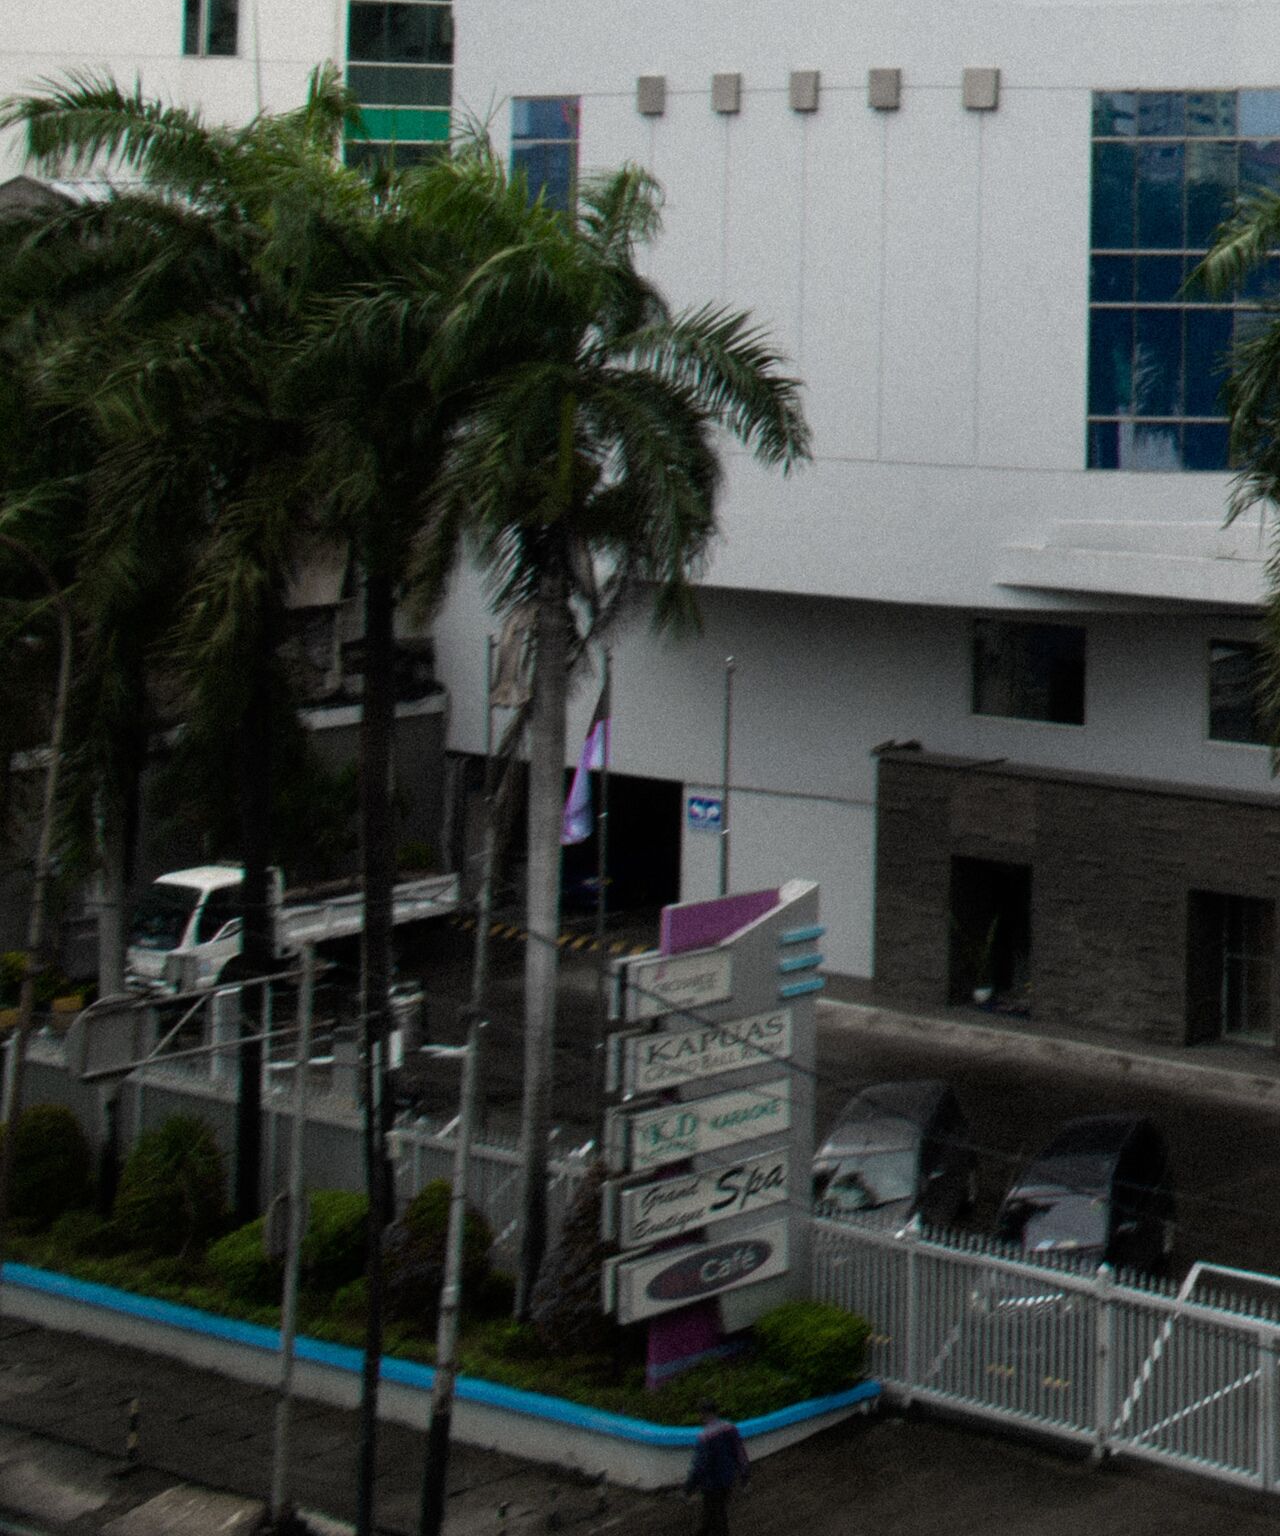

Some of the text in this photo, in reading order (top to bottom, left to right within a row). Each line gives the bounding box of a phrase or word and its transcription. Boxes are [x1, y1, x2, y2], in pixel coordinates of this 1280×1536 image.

[647, 1017, 782, 1064] KAPUAS
[711, 1099, 779, 1128] KARAOKE
[711, 1165, 784, 1210] Spa
